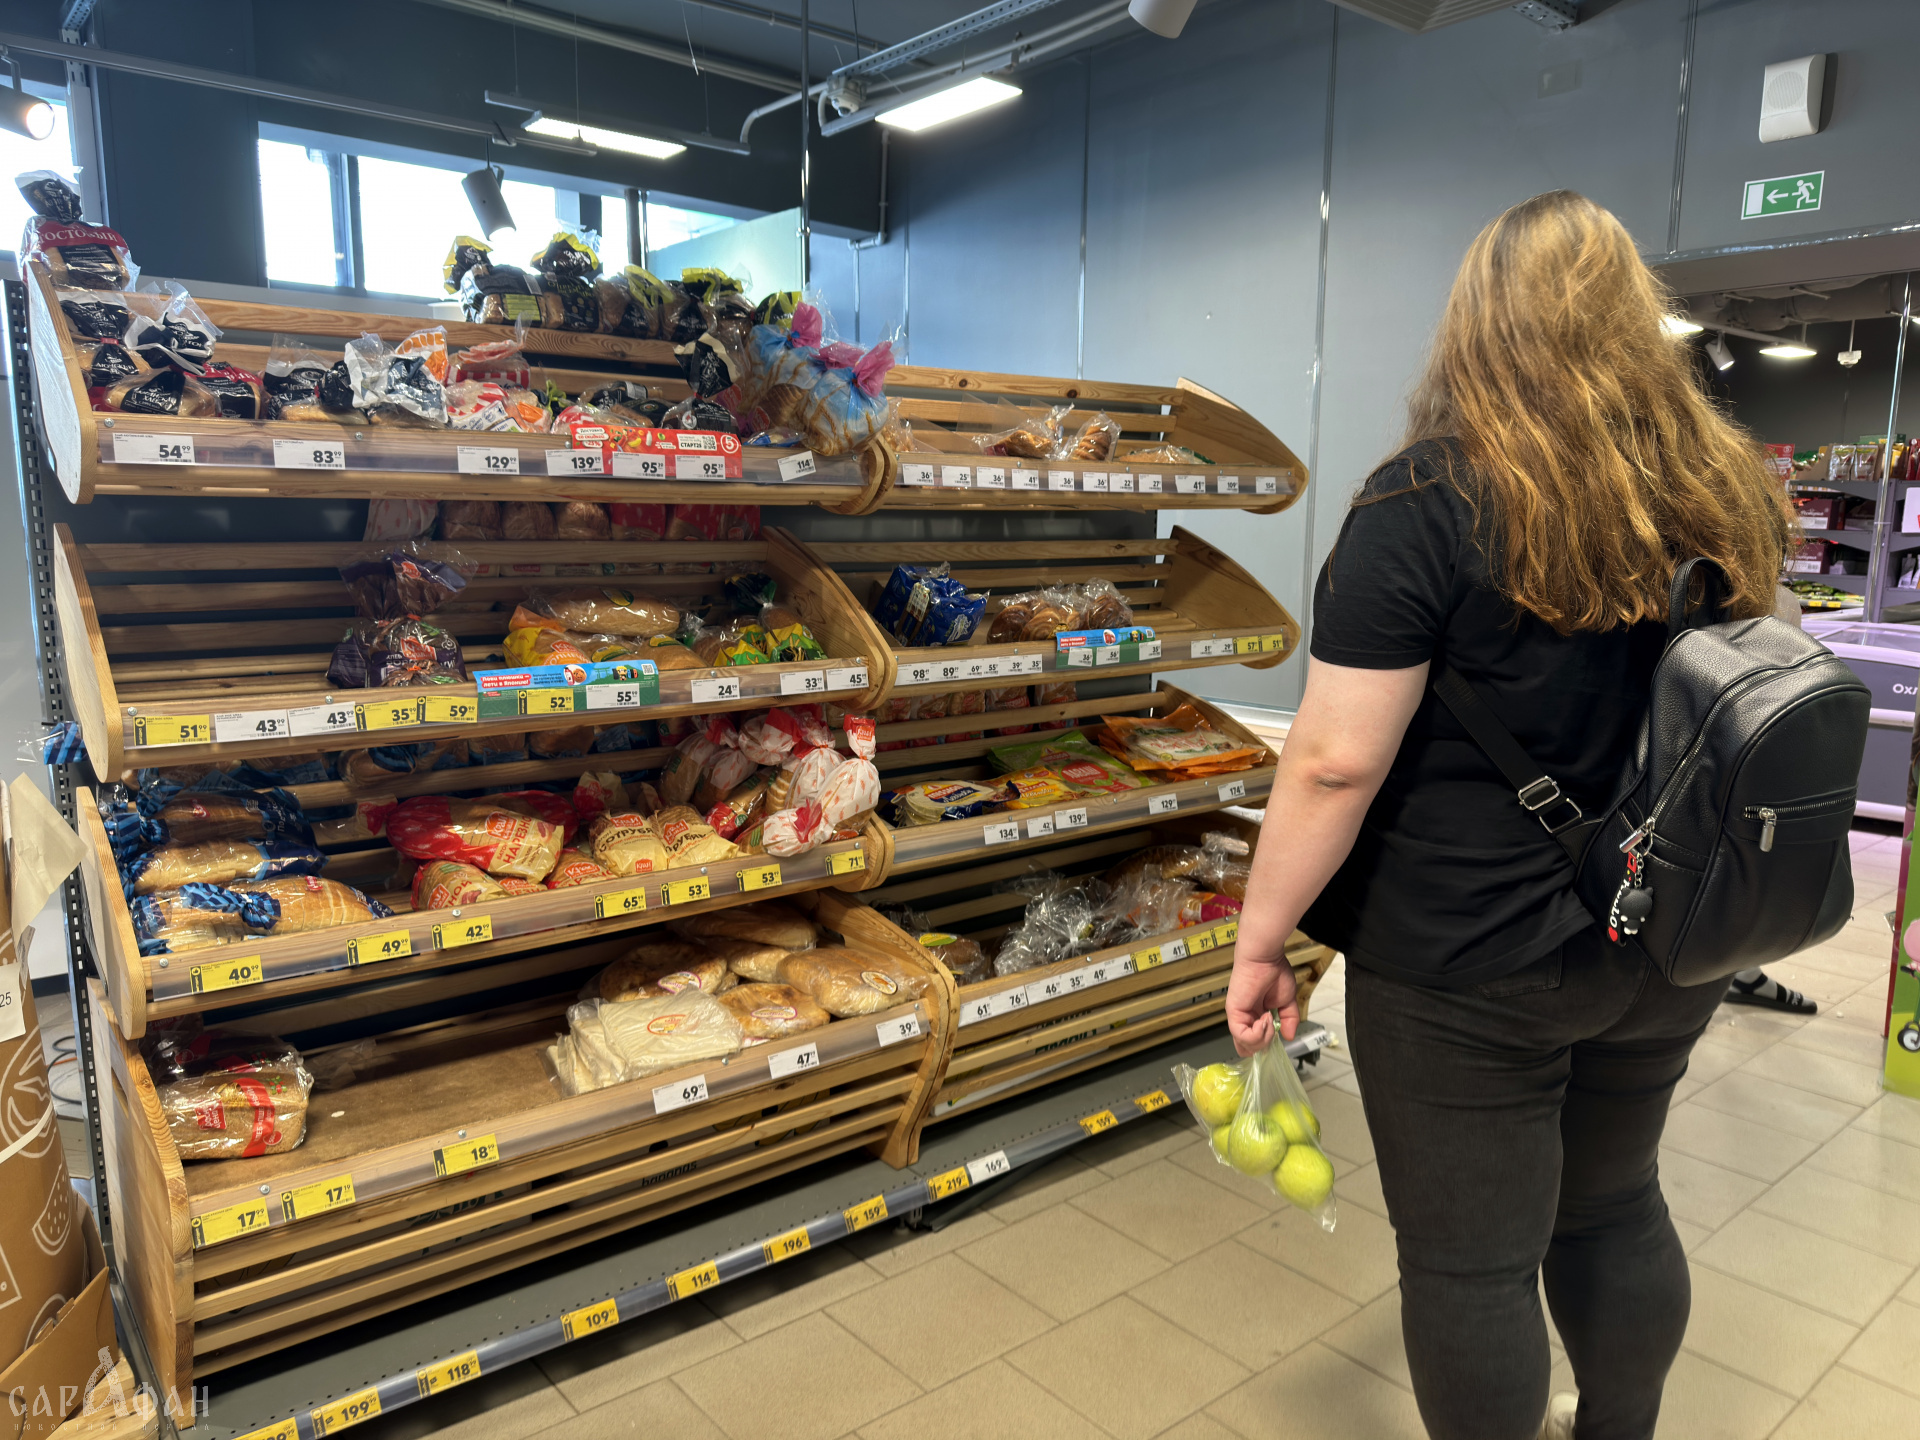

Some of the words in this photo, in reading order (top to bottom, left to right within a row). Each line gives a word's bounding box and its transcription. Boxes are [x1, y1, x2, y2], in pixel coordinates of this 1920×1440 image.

[159, 444, 182, 458] 54
[313, 451, 334, 463] 83
[485, 456, 510, 469] 129
[571, 457, 594, 469] 139
[642, 462, 657, 473] 95
[797, 459, 810, 468] 114
[703, 464, 718, 474] 95
[805, 678, 817, 688] 33
[849, 674, 862, 683] 45
[616, 691, 631, 702] 55
[718, 685, 732, 696] 24
[550, 697, 565, 708] 52
[392, 708, 410, 721] 35
[449, 705, 468, 717] 59
[327, 712, 347, 724] 43
[180, 725, 198, 738] 51
[255, 720, 278, 732] 43
[849, 857, 859, 867] 71
[762, 872, 775, 883] 53
[688, 885, 702, 896] 53
[623, 896, 638, 908] 65
[466, 926, 484, 937] 42
[382, 940, 401, 953] 49
[228, 966, 252, 980] 40
[899, 1022, 912, 1035] 39
[797, 1053, 810, 1065] 47
[682, 1085, 699, 1099] 69
[471, 1146, 488, 1161] 18
[985, 1159, 1002, 1173] 169
[947, 1177, 962, 1192] 219
[326, 1186, 343, 1203] 17
[237, 1210, 256, 1228] 17
[863, 1207, 880, 1222] 159
[783, 1236, 803, 1253] 196
[691, 1271, 712, 1288] 114
[586, 1310, 609, 1327] 109
[447, 1362, 470, 1381] 118
[341, 1401, 370, 1422] 199
